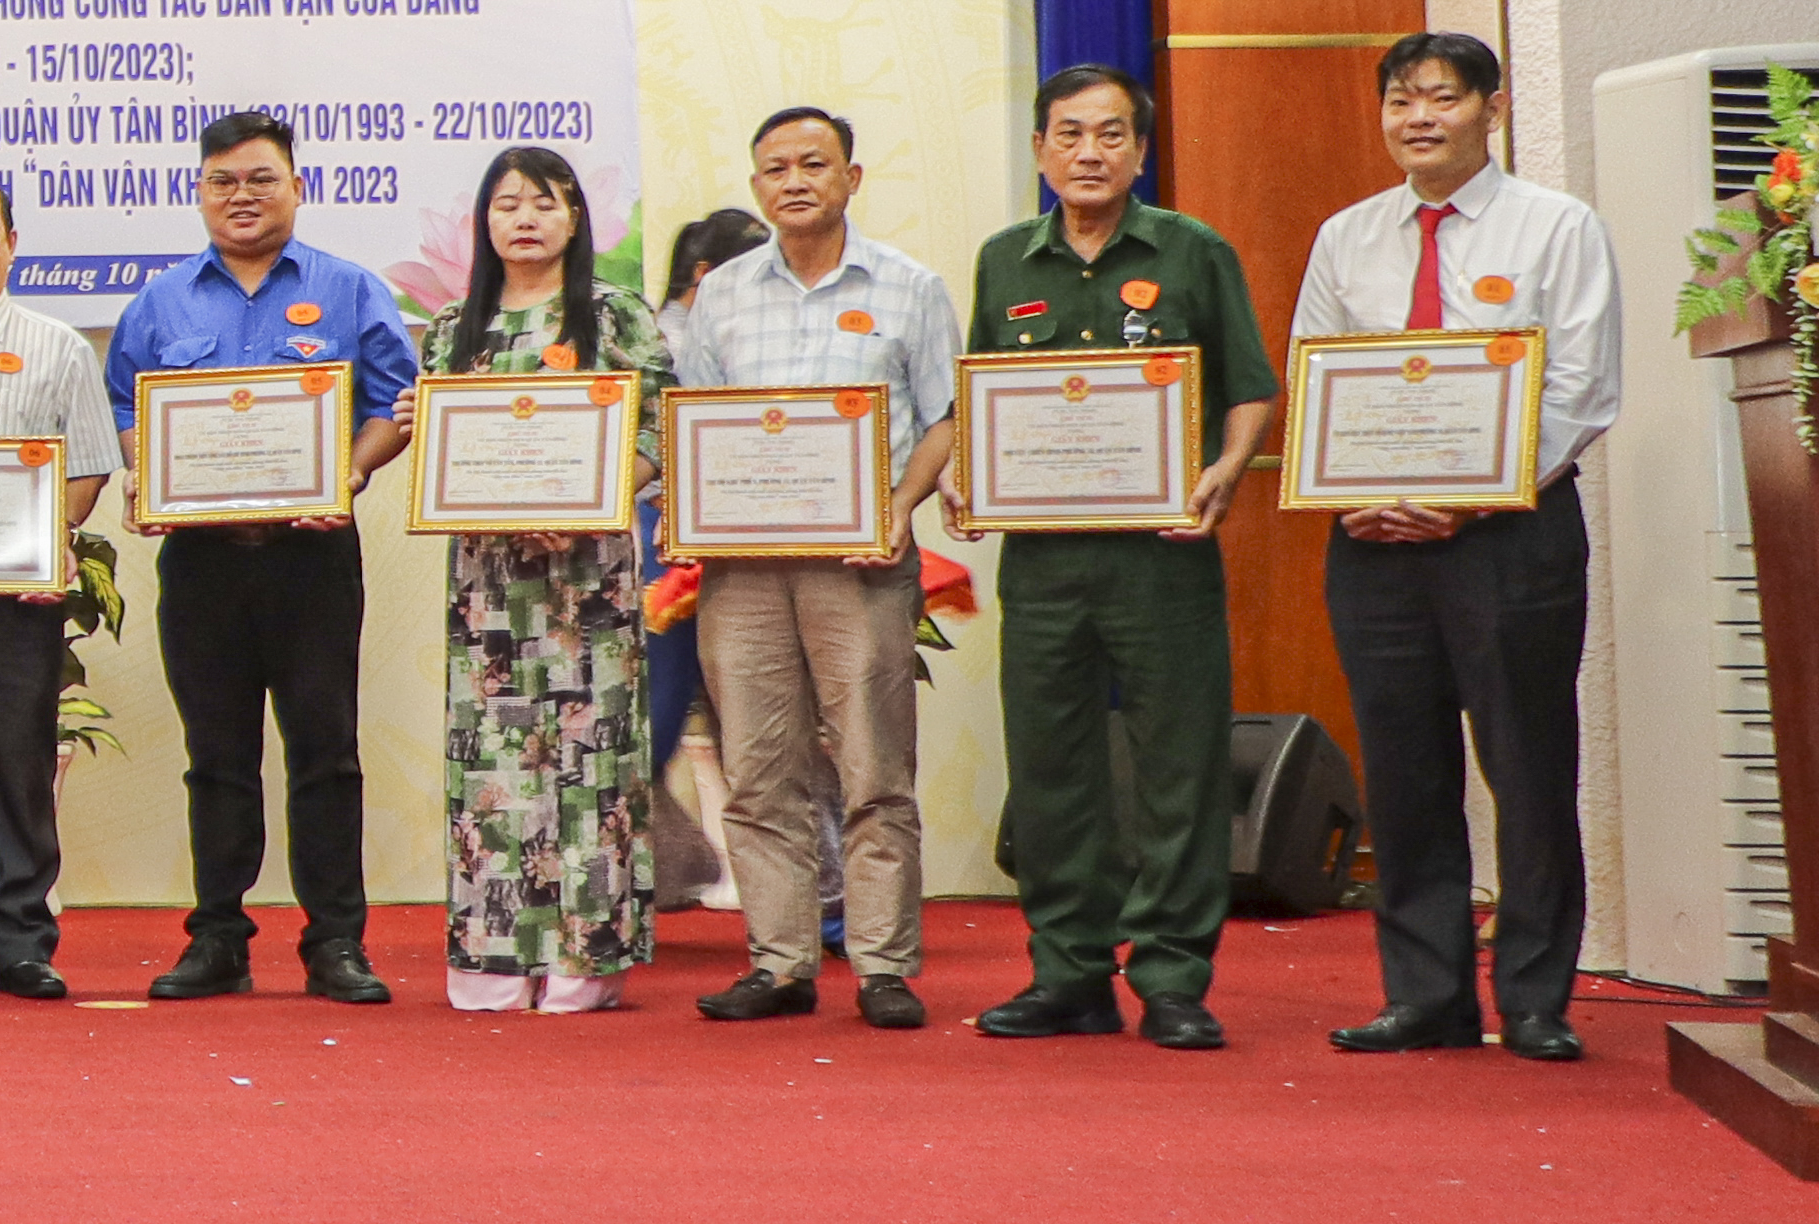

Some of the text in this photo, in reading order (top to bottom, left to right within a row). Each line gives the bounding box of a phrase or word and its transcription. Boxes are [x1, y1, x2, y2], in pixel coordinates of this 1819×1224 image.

[25, 42, 194, 86] 15/10/2023);
[68, 93, 102, 145] ỦY
[111, 97, 162, 144] TÂN
[172, 96, 235, 143] BÌ
[432, 100, 593, 144] 22/10/2023)
[102, 160, 156, 216] VẬN
[333, 166, 399, 204] 2023
[18, 263, 96, 292] tháng
[104, 262, 139, 286] 10
